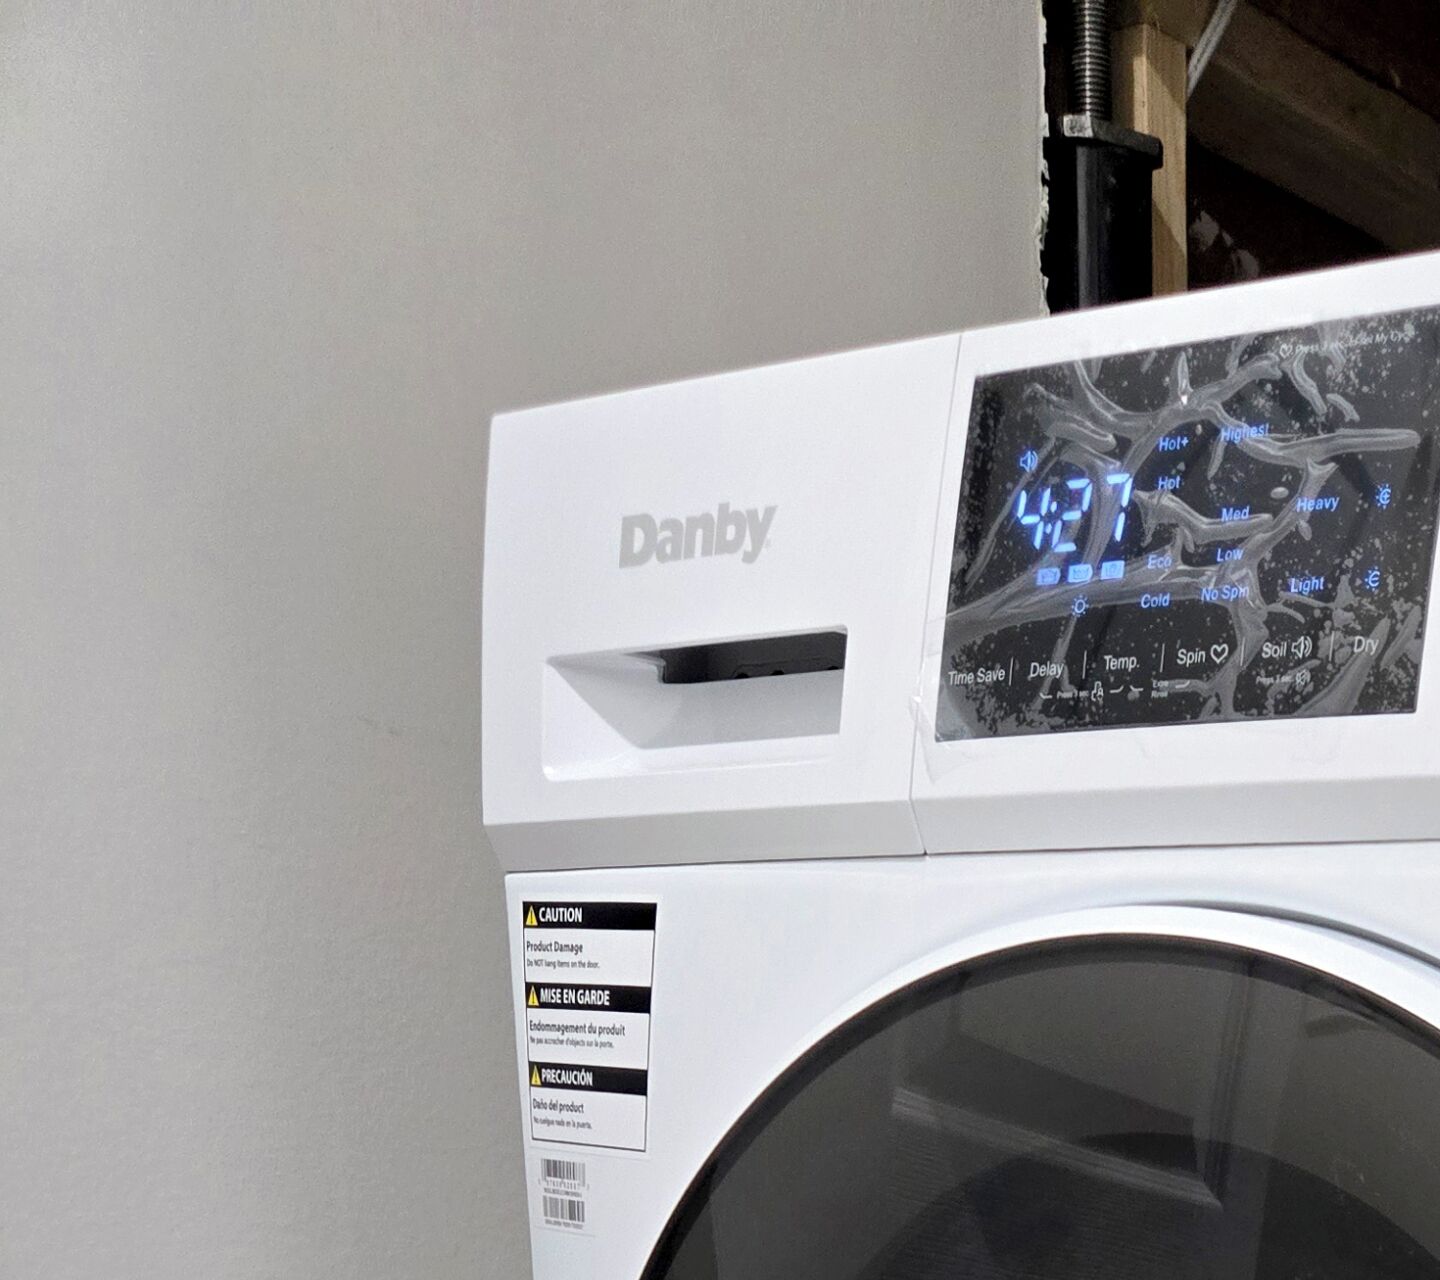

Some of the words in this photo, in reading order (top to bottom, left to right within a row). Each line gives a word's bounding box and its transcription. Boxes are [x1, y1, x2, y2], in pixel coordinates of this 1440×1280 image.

[1158, 475, 1181, 490] Hot
[1017, 473, 1133, 551] 4:27
[1297, 497, 1339, 513] Heavy
[1221, 506, 1250, 522] Med
[619, 502, 778, 568] Danby
[1147, 554, 1172, 569] Eco
[1217, 548, 1244, 562] Low
[1291, 576, 1324, 595] Light
[1140, 593, 1170, 609] Cold
[1202, 588, 1219, 601] No
[1262, 642, 1287, 658] Soil
[1354, 637, 1379, 655] Dry
[1104, 655, 1140, 672] Temp.
[1177, 649, 1206, 667] Spin
[949, 670, 974, 685] Time
[977, 667, 1005, 683] Save
[1030, 662, 1064, 679] Delay
[539, 907, 582, 923] CAUTION
[527, 941, 552, 953] Product
[554, 941, 583, 955] Damage
[578, 960, 586, 968] the
[540, 988, 561, 1003] MISE
[563, 989, 575, 1003] EN
[577, 990, 610, 1006] GARDE
[530, 1020, 586, 1036] Endommagement
[588, 1022, 596, 1034] du
[598, 1024, 625, 1037] produit
[541, 1068, 593, 1086] PRECAUCIÓN
[549, 1099, 558, 1111] del
